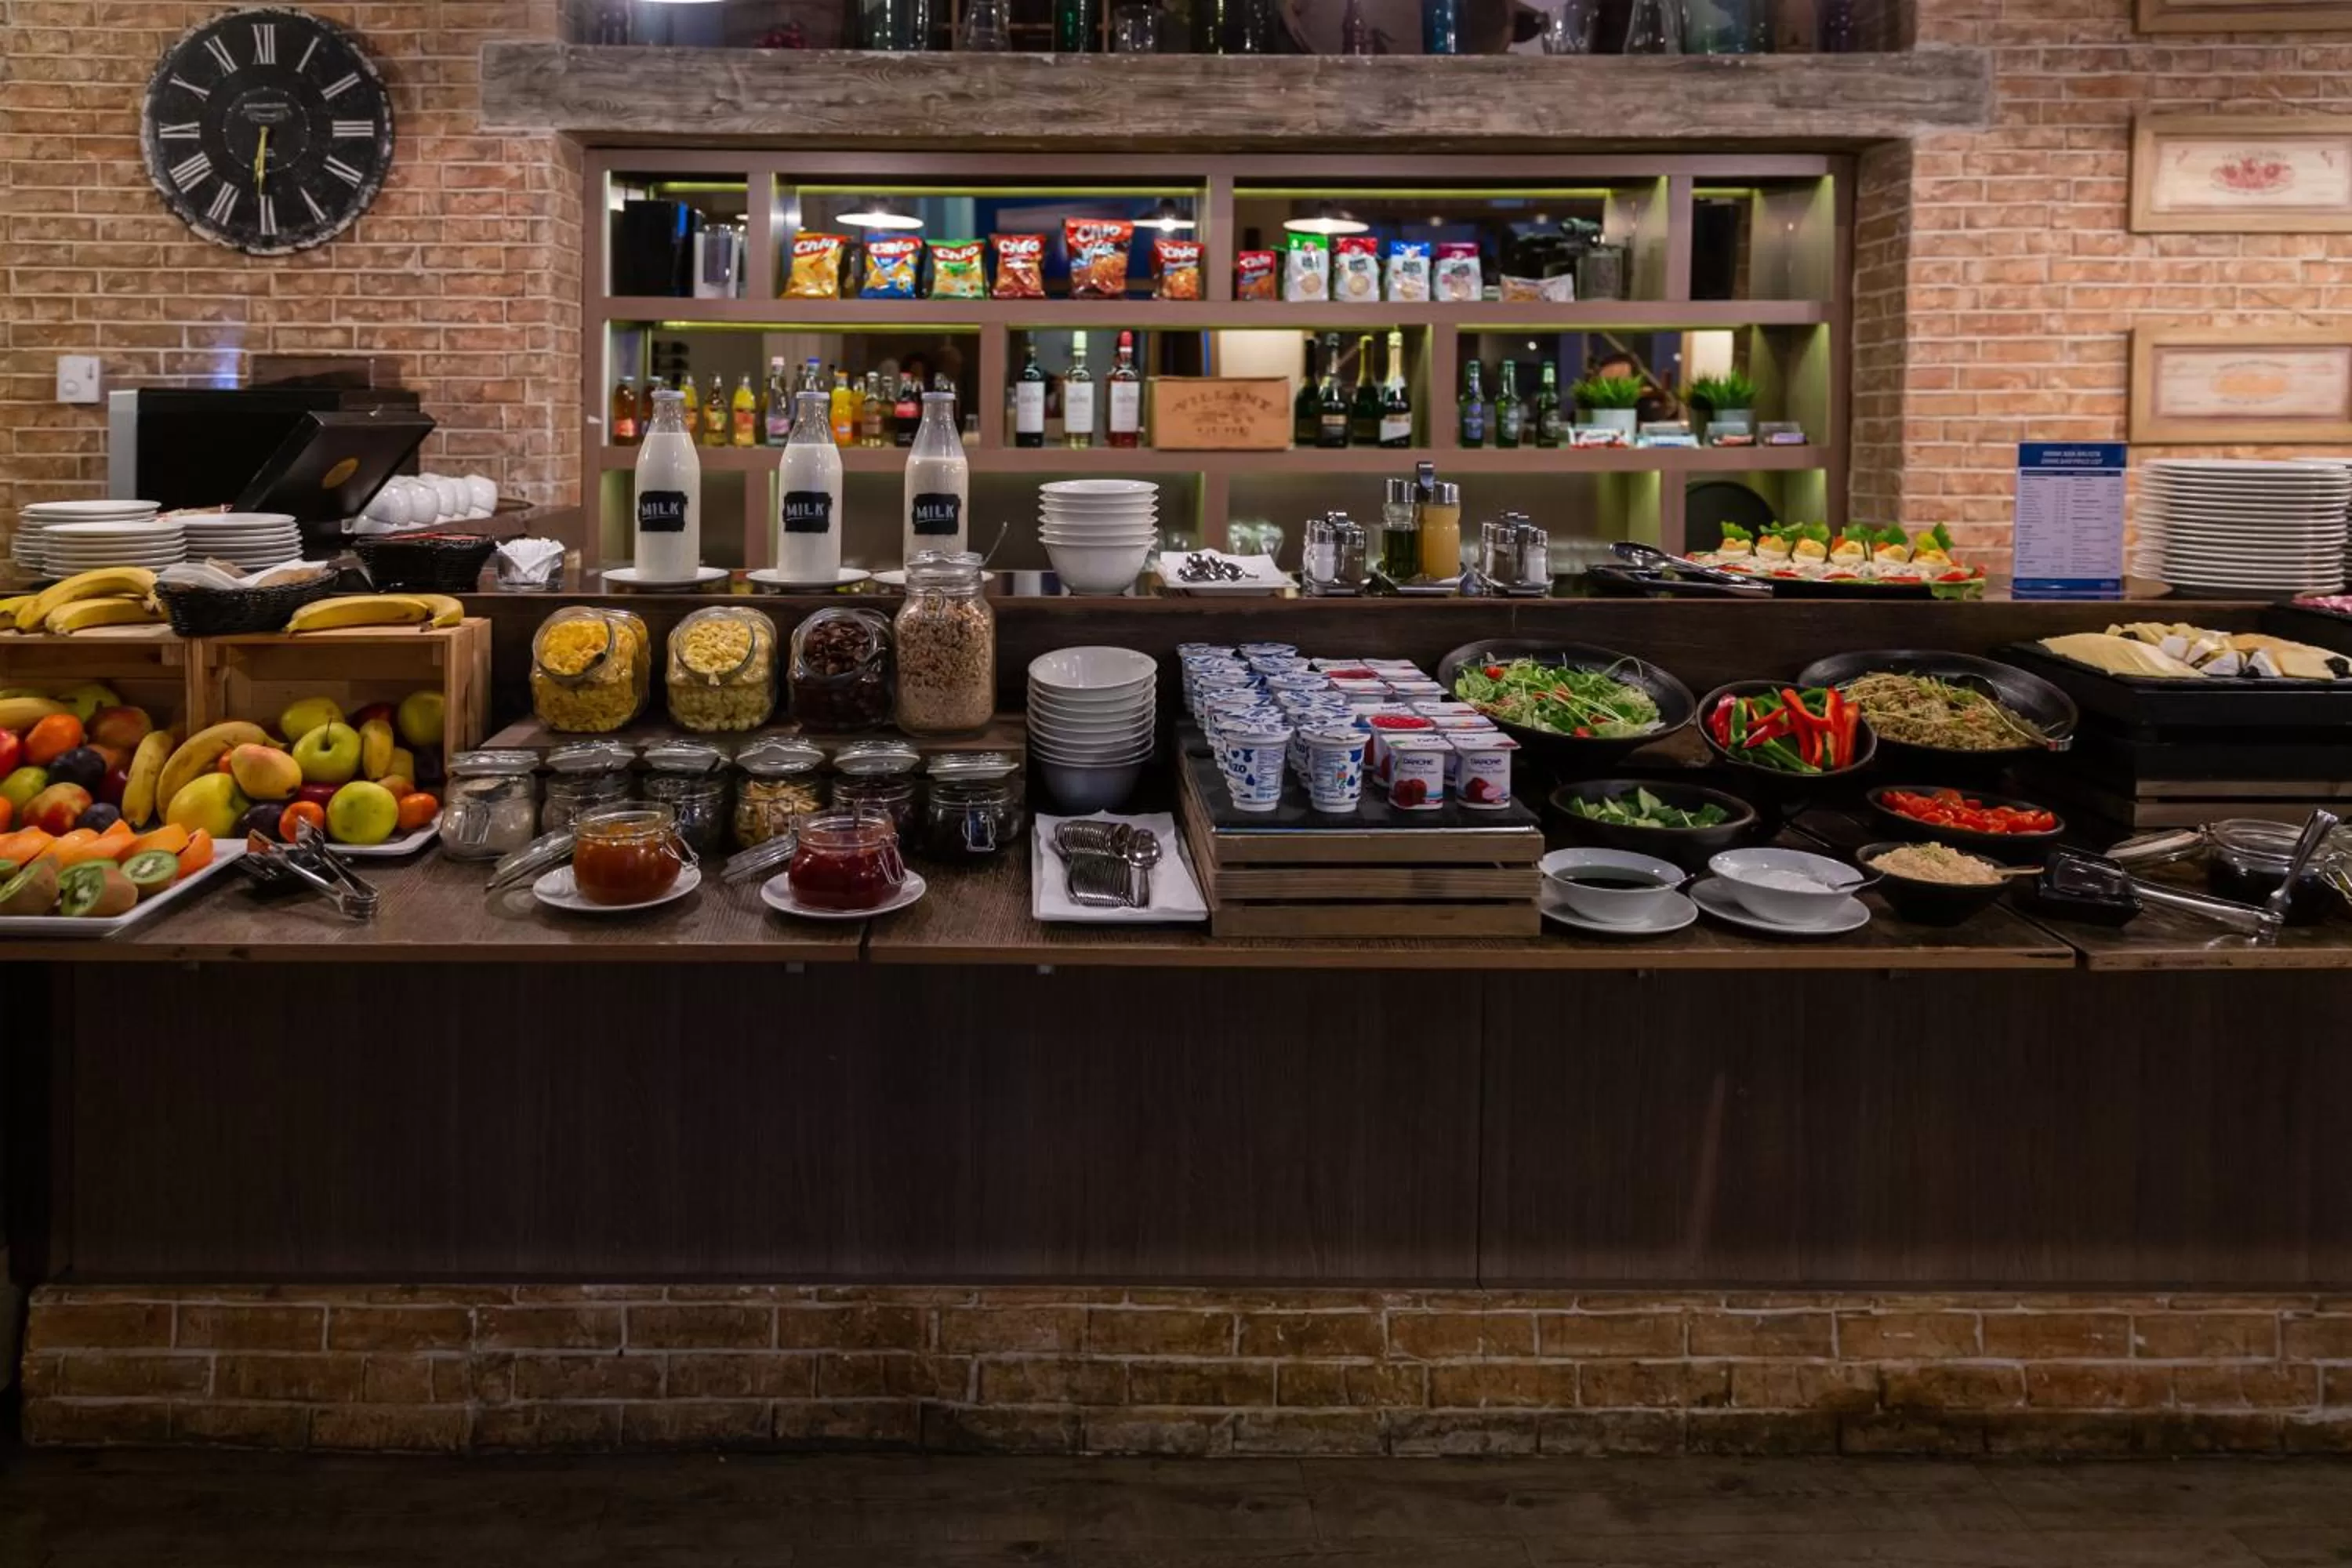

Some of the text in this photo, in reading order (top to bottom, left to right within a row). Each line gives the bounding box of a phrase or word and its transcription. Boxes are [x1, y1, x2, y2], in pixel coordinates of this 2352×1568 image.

[204, 35, 238, 78] XI
[251, 24, 276, 64] XII
[295, 36, 321, 74] I
[169, 73, 210, 102] X
[320, 72, 361, 101] II
[158, 121, 201, 139] IX
[332, 120, 374, 137] III
[169, 151, 213, 194] VIII
[322, 154, 364, 189] IV
[206, 181, 240, 227] VII
[300, 187, 327, 224] V
[642, 502, 678, 515] MILK
[786, 503, 824, 516] MILK
[917, 504, 954, 518] MILK
